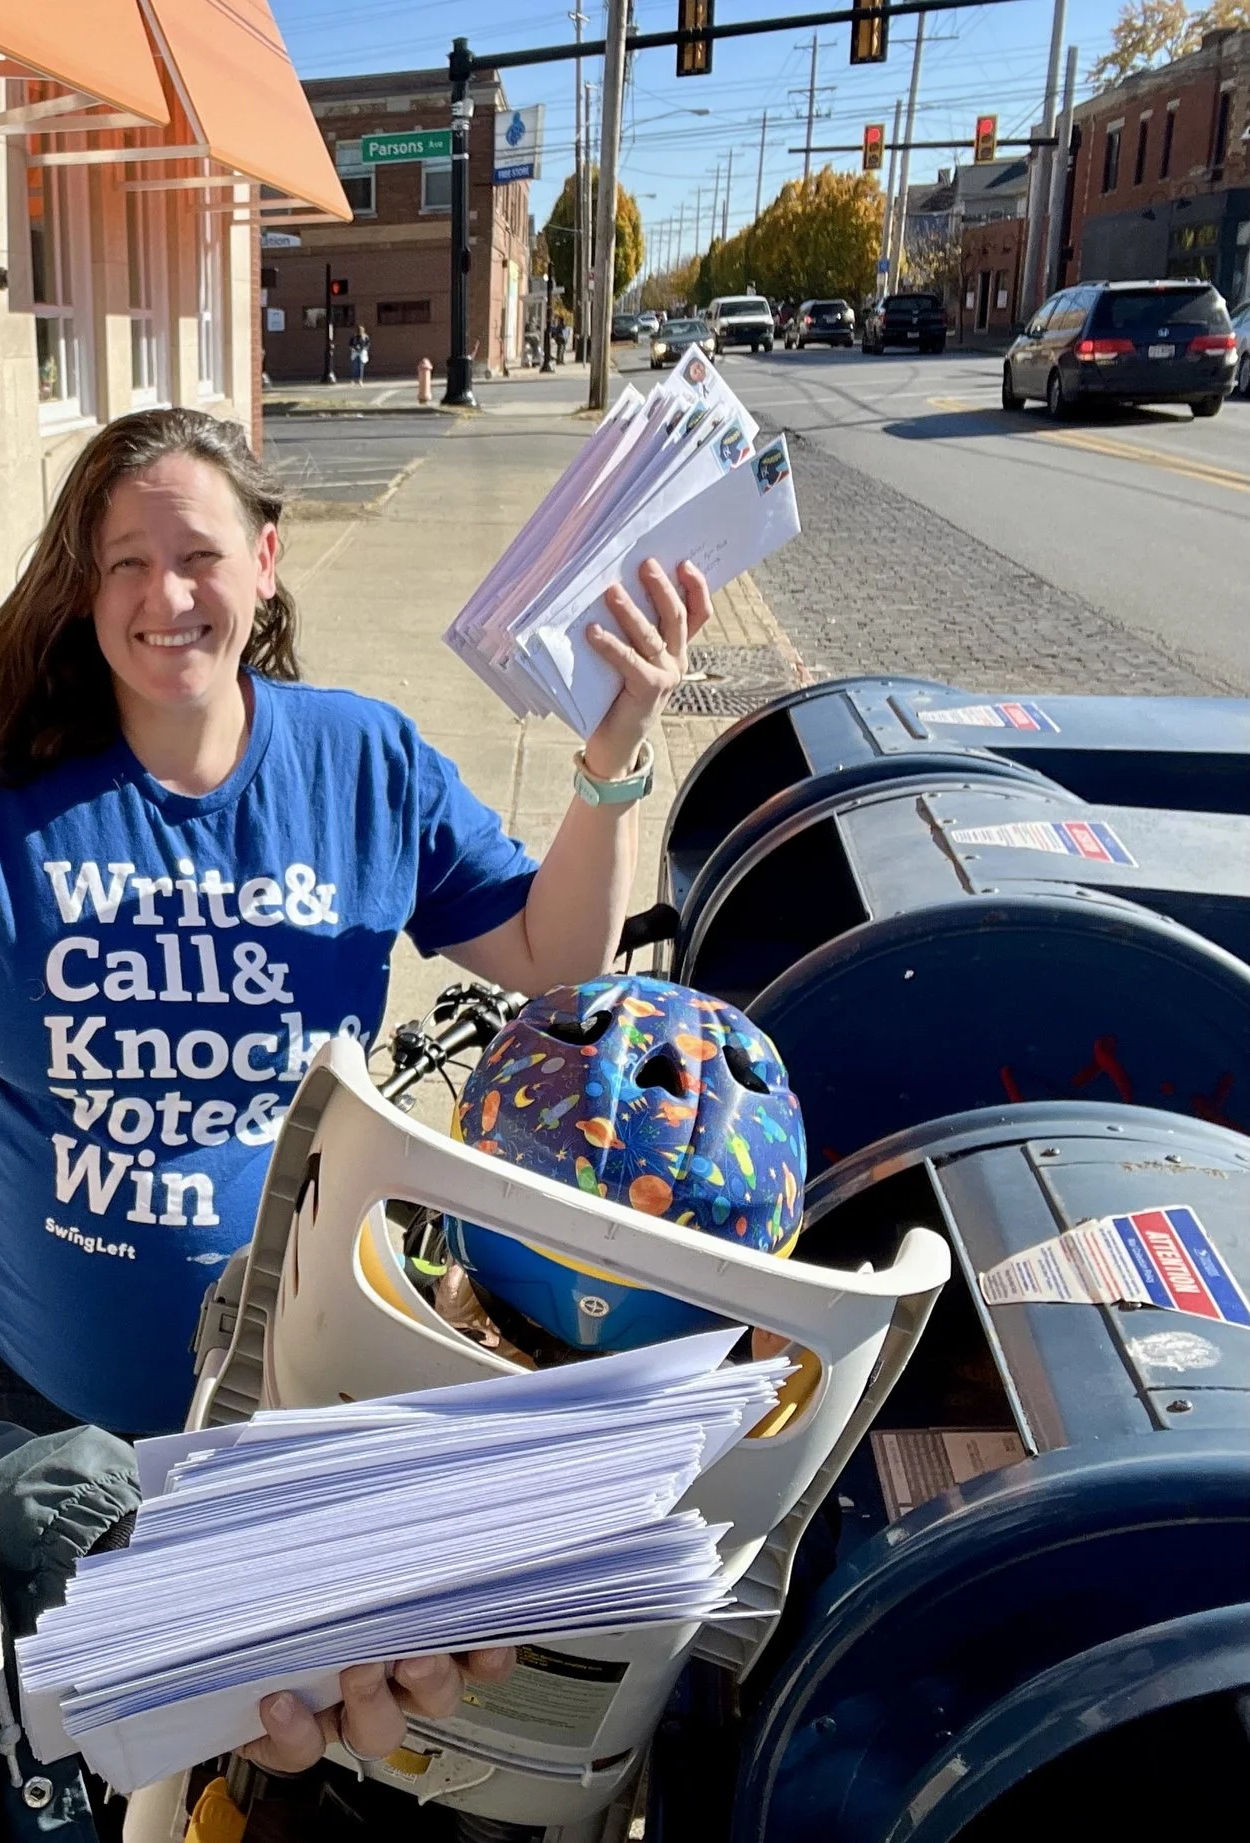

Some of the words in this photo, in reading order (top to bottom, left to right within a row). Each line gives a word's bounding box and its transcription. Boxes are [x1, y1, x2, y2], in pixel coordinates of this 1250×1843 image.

[369, 142, 423, 157] Parsons
[44, 859, 339, 928] Write&
[46, 934, 294, 1005] Call&
[52, 1133, 220, 1226] Win
[1145, 1230, 1200, 1294] ATTENTION
